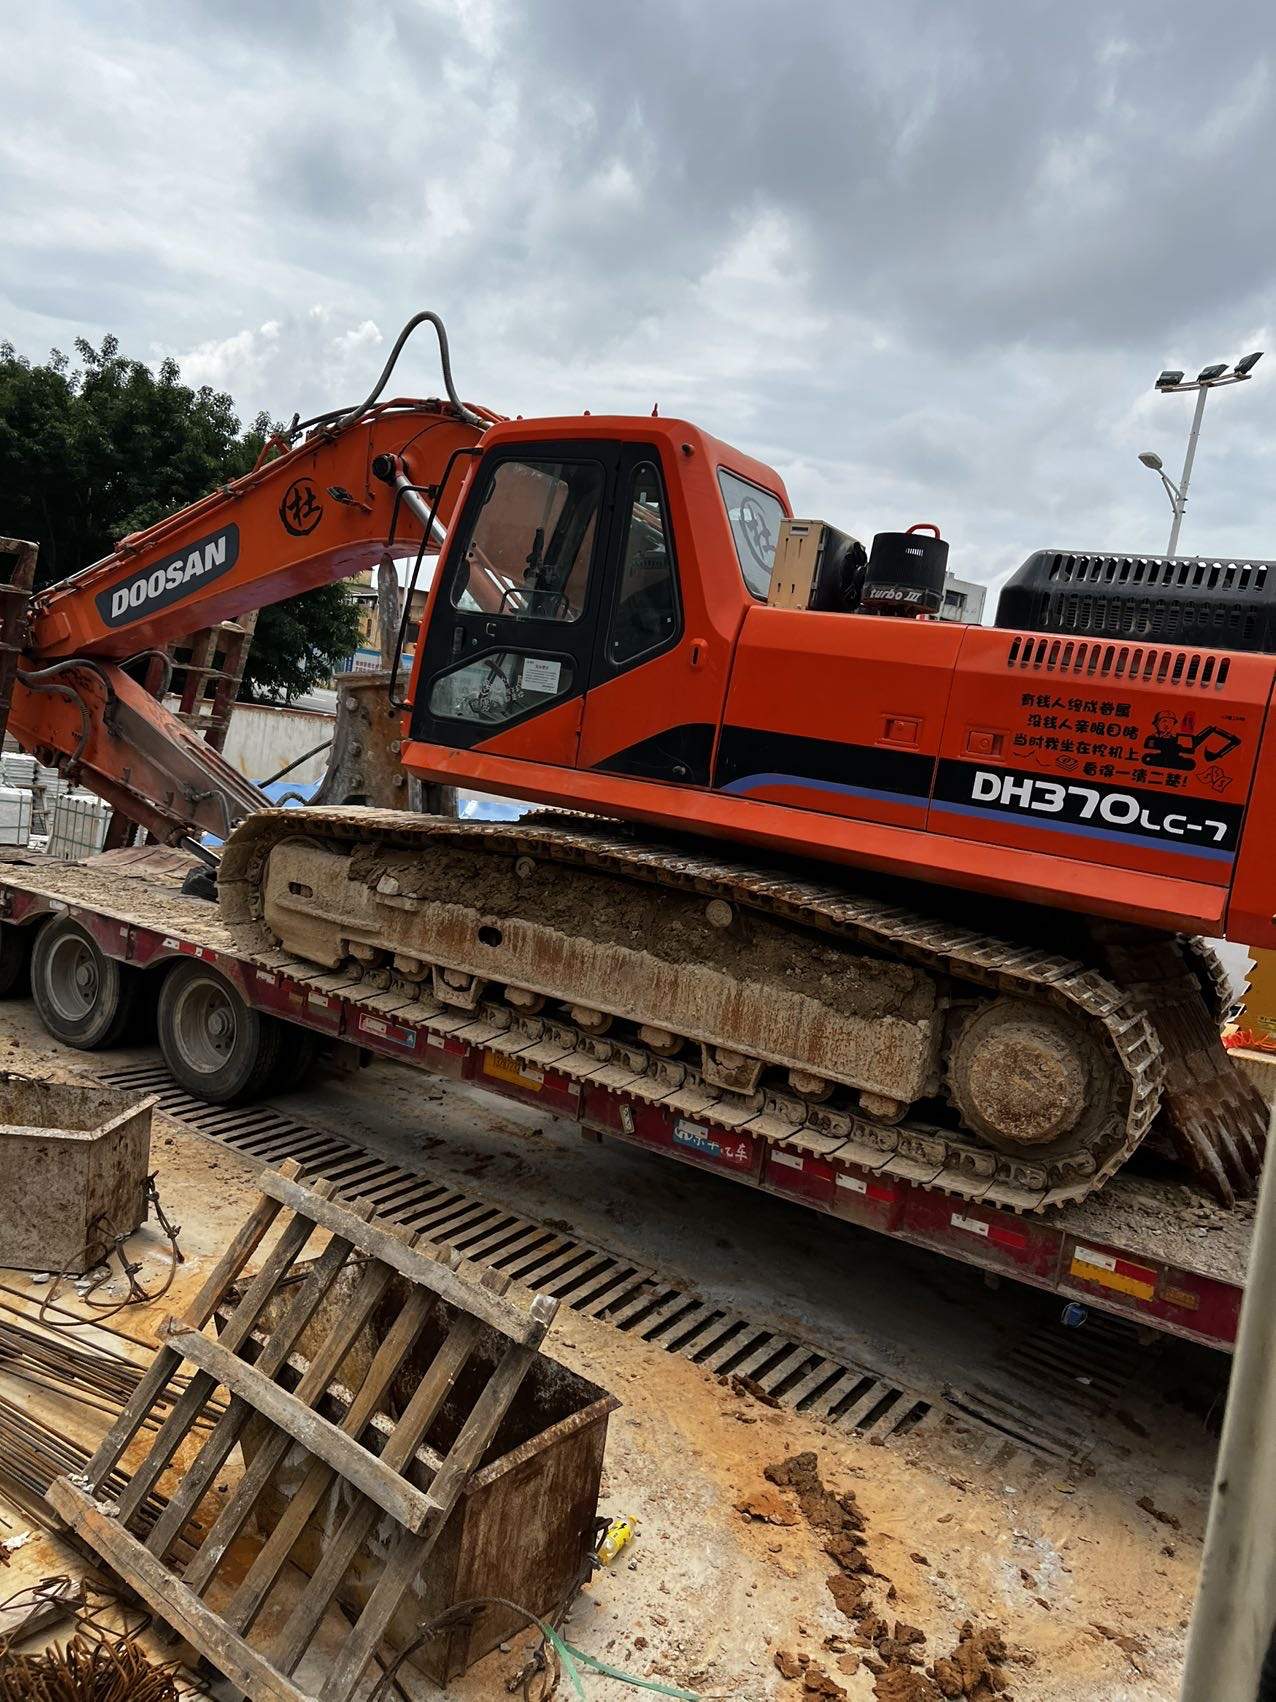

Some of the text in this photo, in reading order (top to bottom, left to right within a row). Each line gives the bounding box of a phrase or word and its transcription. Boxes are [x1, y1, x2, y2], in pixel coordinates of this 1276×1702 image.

[111, 535, 227, 619] DOOSAN
[869, 588, 903, 600] turbo
[1021, 693, 1131, 718] 有钱人终成眷属
[1026, 713, 1139, 740] 没钱人亲眼目睹
[1013, 732, 1139, 761] 当时我坐在挖机上
[971, 771, 1228, 841] DH370LC-7
